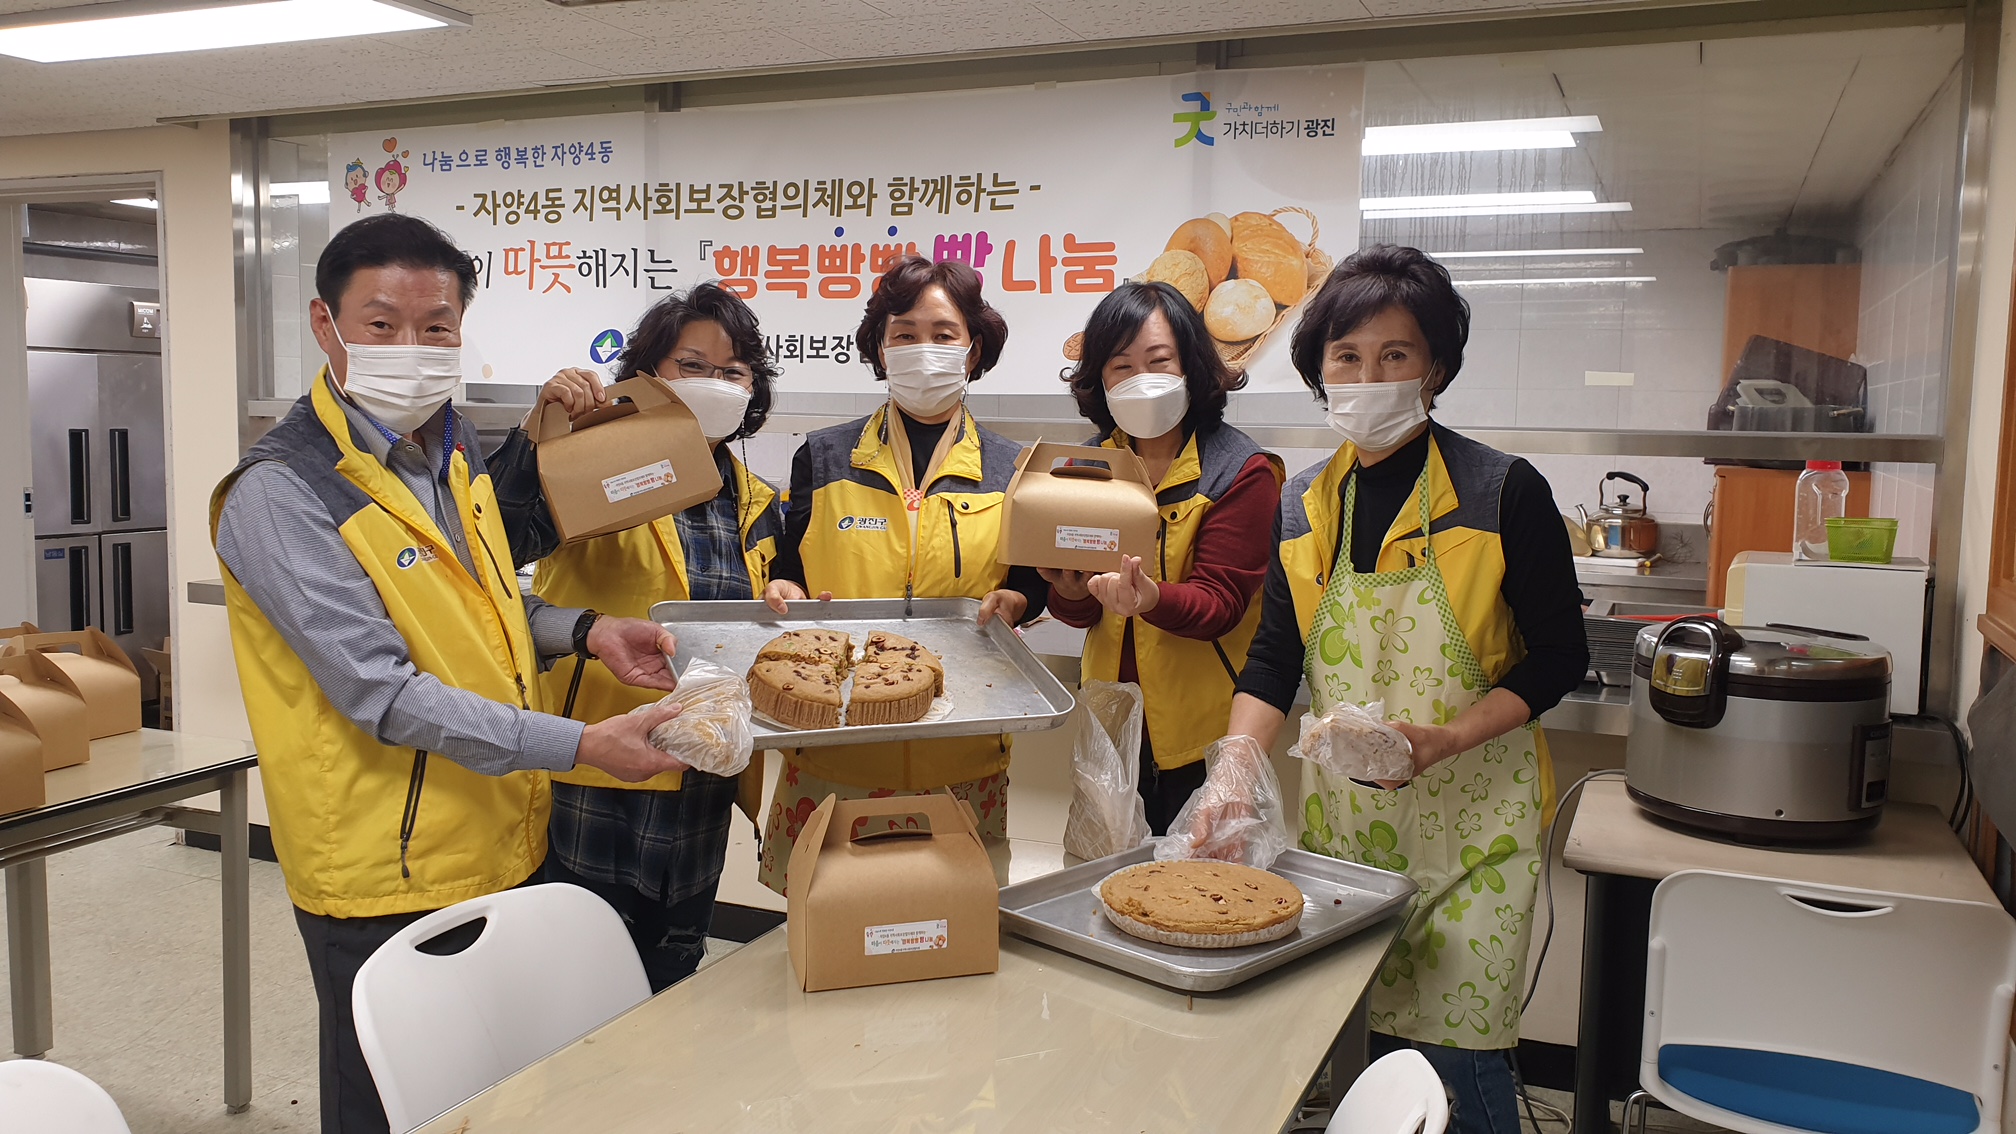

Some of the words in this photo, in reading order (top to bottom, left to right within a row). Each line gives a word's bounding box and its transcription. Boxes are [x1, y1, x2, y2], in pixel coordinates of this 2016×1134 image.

[1223, 119, 1300, 139] 가치더하기
[1303, 118, 1336, 138] 광진
[422, 149, 489, 172] 나눔으로
[495, 144, 547, 170] 행복한
[551, 140, 614, 167] 자양4동
[472, 187, 566, 226] 자양4동
[572, 178, 878, 222] 지역사회보장협의체와
[887, 172, 1020, 216] 함께하는
[502, 239, 678, 294] 따뜻해지는
[858, 517, 887, 525] 광진구
